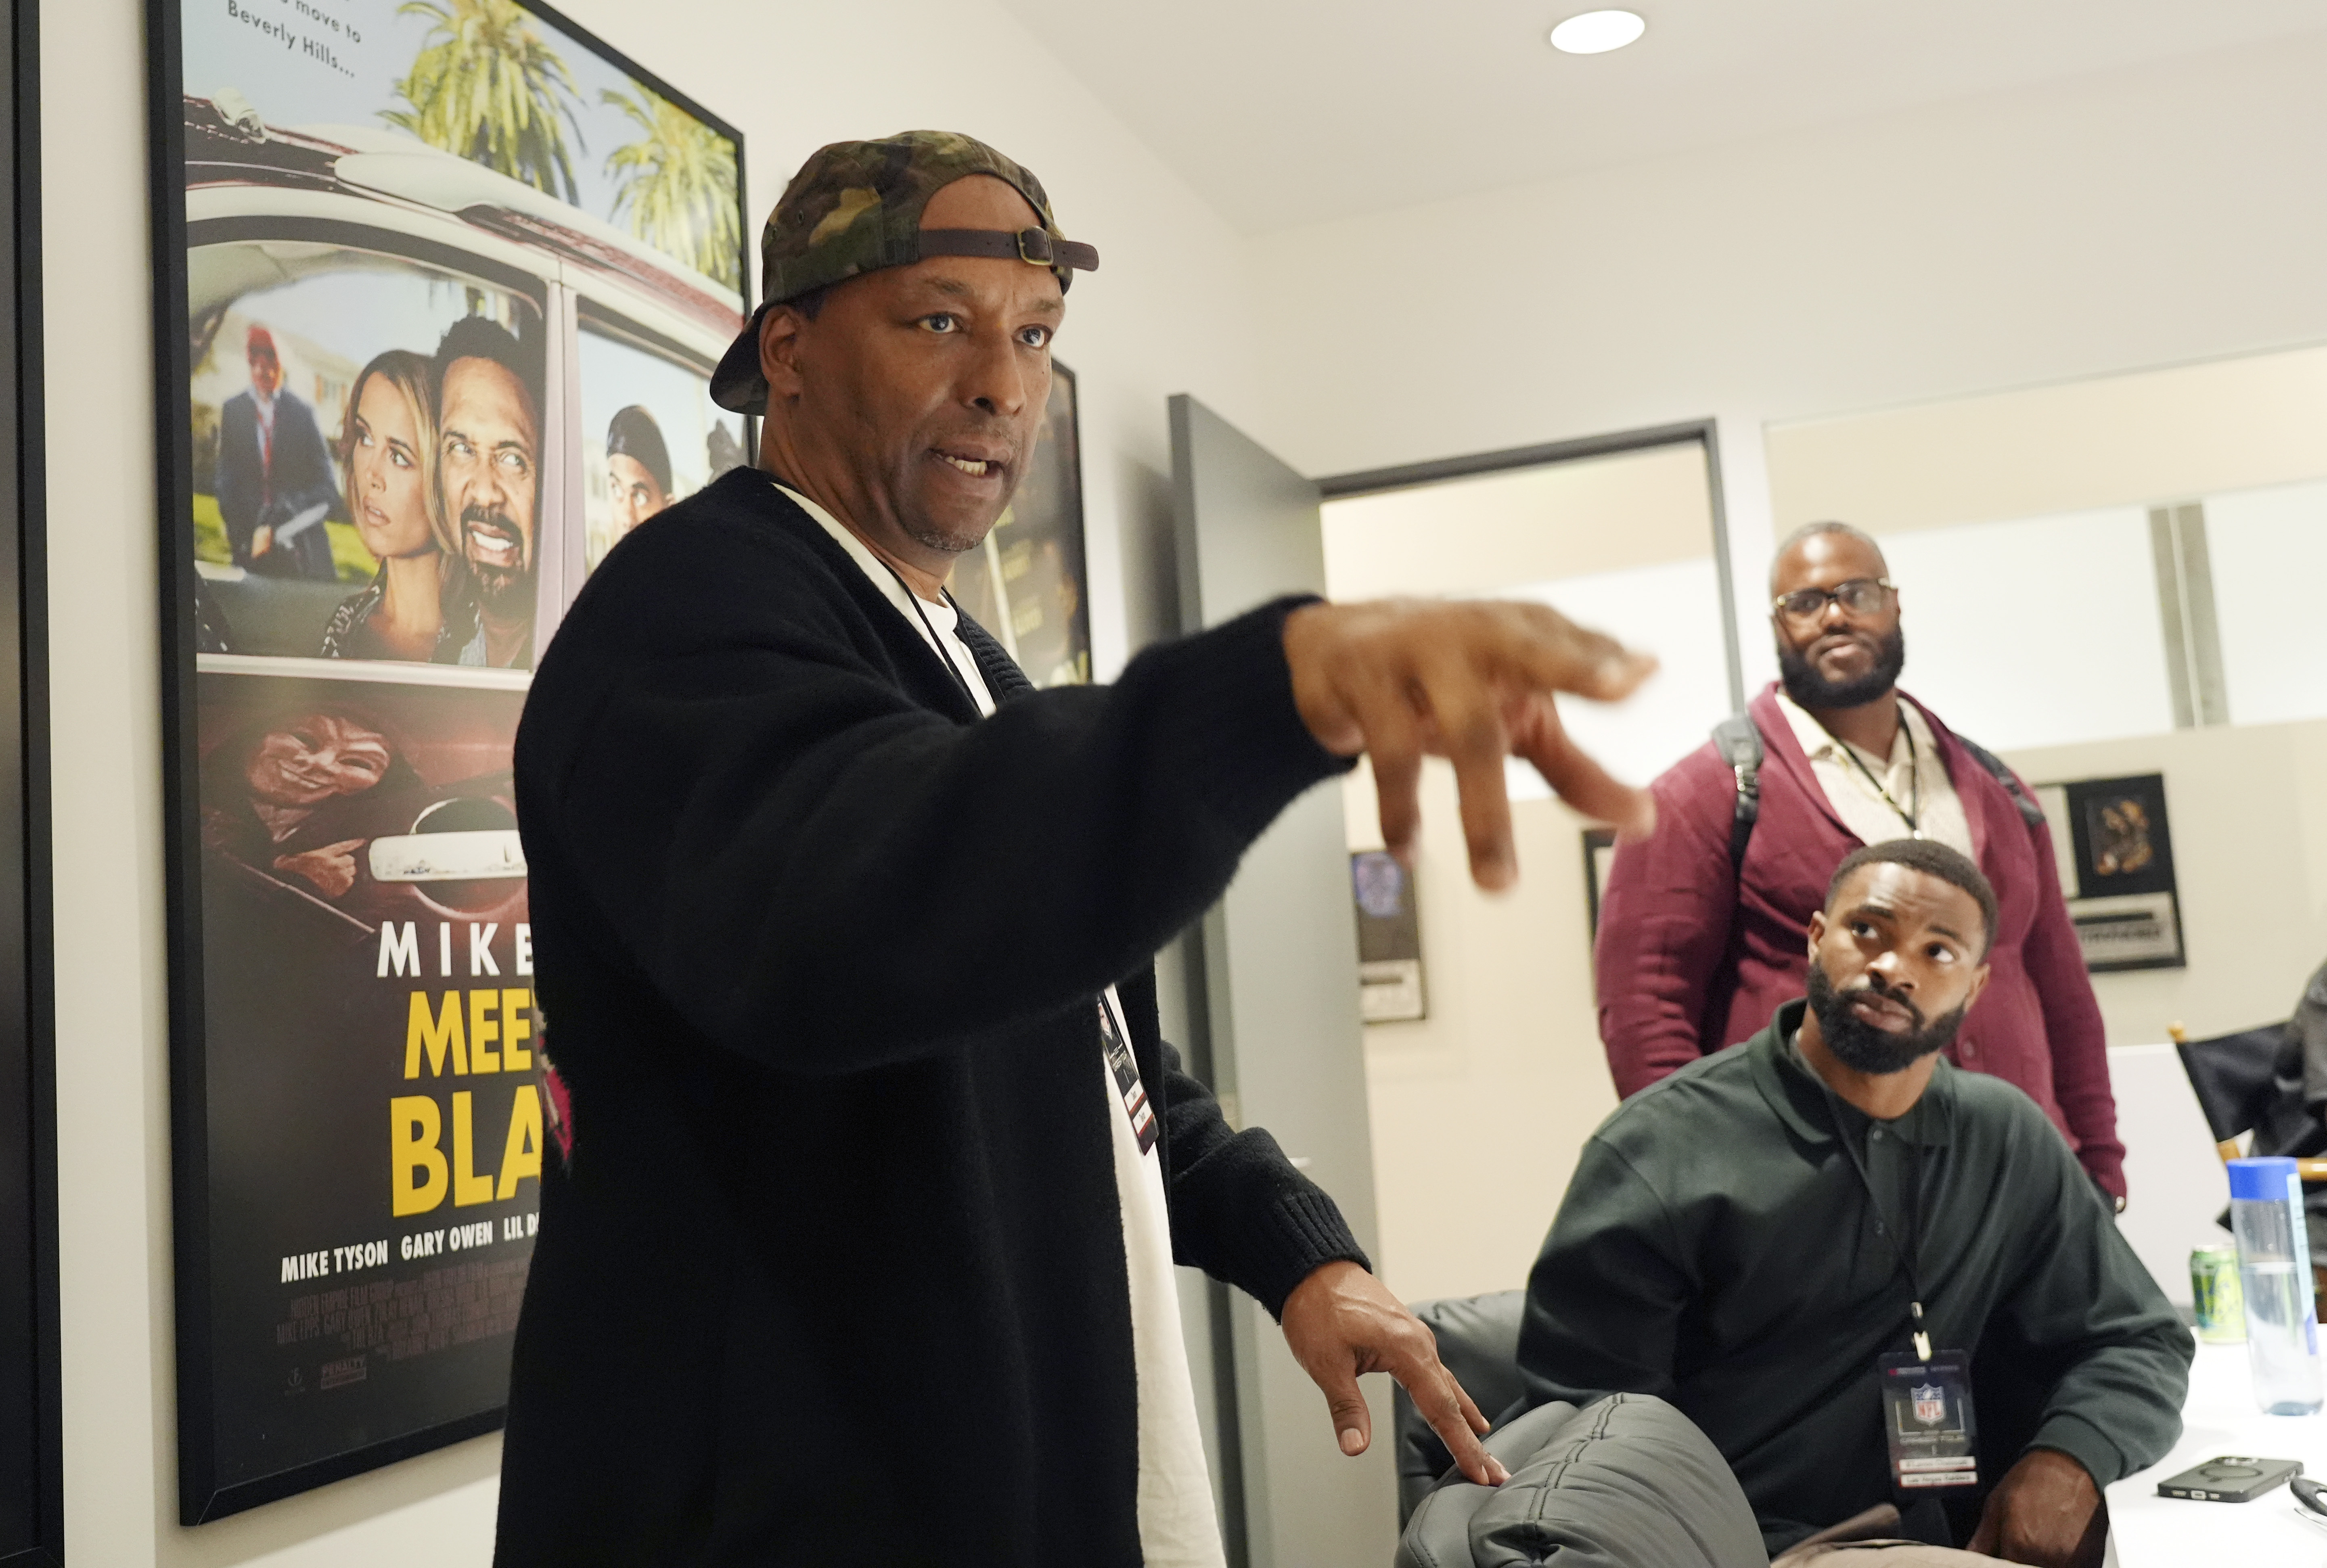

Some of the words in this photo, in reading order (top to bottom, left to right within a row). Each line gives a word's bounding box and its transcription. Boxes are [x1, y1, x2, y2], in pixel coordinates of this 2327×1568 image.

[228, 0, 296, 50] Beverly
[303, 36, 355, 77] Hills...
[296, 0, 340, 32] move
[346, 23, 361, 43] to
[377, 921, 534, 978] MIKE
[404, 988, 535, 1080] MEE
[391, 1084, 543, 1217] BLA
[281, 1250, 329, 1284] MIKE
[333, 1240, 388, 1274] TYSON
[401, 1229, 445, 1261] GARY
[450, 1220, 493, 1251] OWEN
[504, 1215, 524, 1241] LIL
